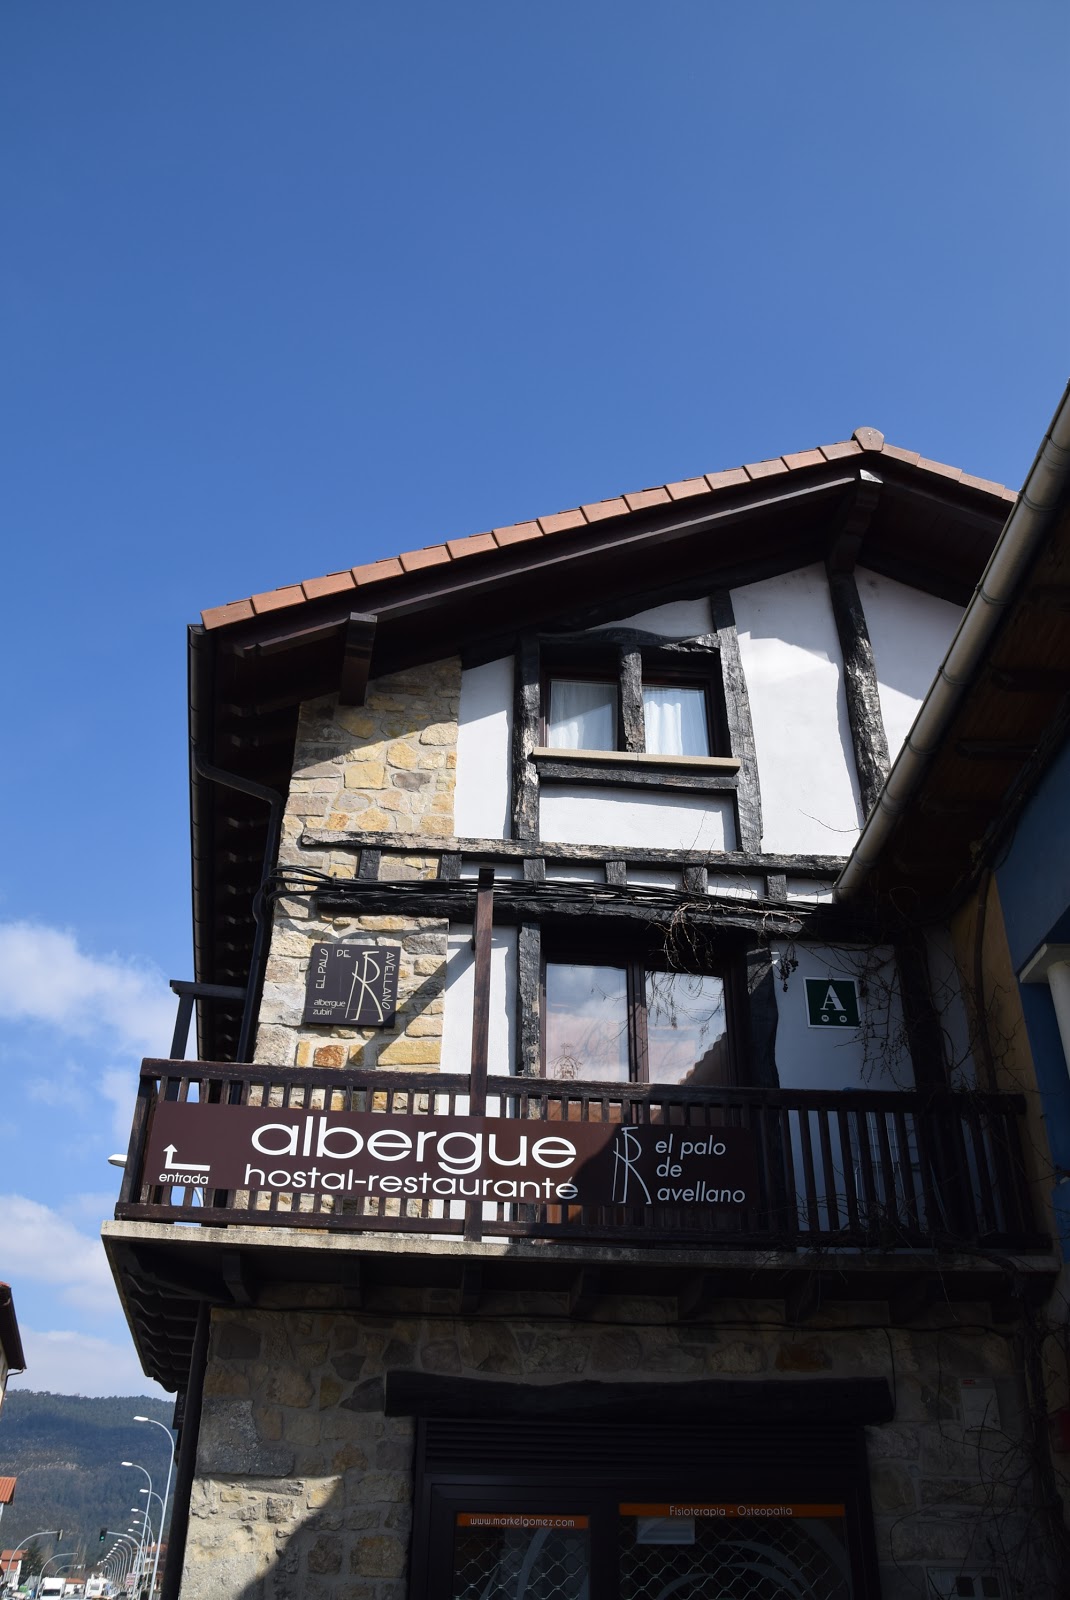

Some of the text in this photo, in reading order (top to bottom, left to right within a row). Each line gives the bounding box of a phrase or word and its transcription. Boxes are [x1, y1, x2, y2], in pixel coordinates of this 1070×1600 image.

[336, 949, 351, 958] DE
[315, 948, 329, 989] EL PALO
[381, 951, 396, 1010] AVELLANO
[313, 998, 346, 1009] albergue
[820, 984, 847, 1011] A
[312, 1008, 333, 1016] zubiri
[251, 1115, 577, 1175] albergue
[655, 1133, 726, 1161] el palo
[158, 1171, 209, 1185] entrada
[656, 1156, 683, 1178] de
[244, 1163, 579, 1200] hostal-restaurante
[657, 1180, 746, 1203] avellano
[470, 1515, 575, 1528] www.markelgomez.com
[669, 1505, 726, 1517] Fisioterapia
[737, 1505, 793, 1517] Osteopatia
